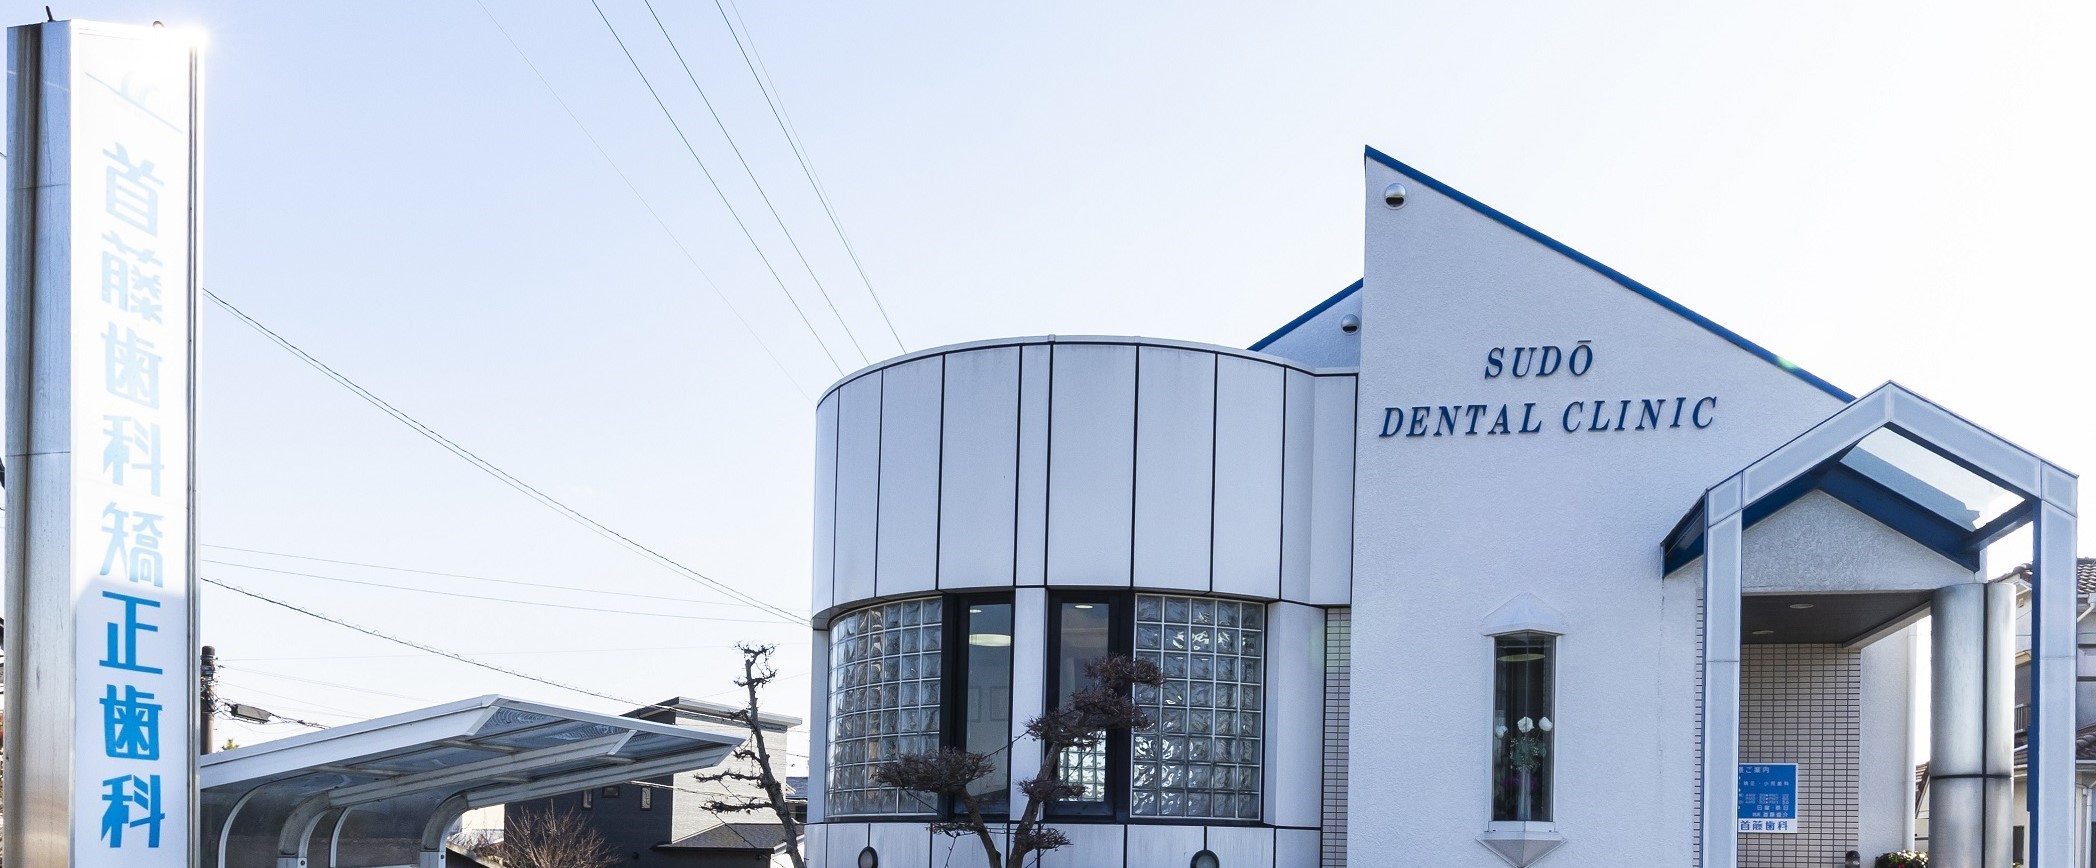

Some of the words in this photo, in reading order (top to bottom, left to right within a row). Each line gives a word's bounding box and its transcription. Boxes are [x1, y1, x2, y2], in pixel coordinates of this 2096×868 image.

[1484, 340, 1593, 379] SUDŌ
[1379, 402, 1542, 437] DENTAL
[1562, 396, 1717, 433] CLINIC
[99, 141, 165, 848] 首藤歯科矯正歯科
[1740, 820, 1788, 830] 首藤歯科
